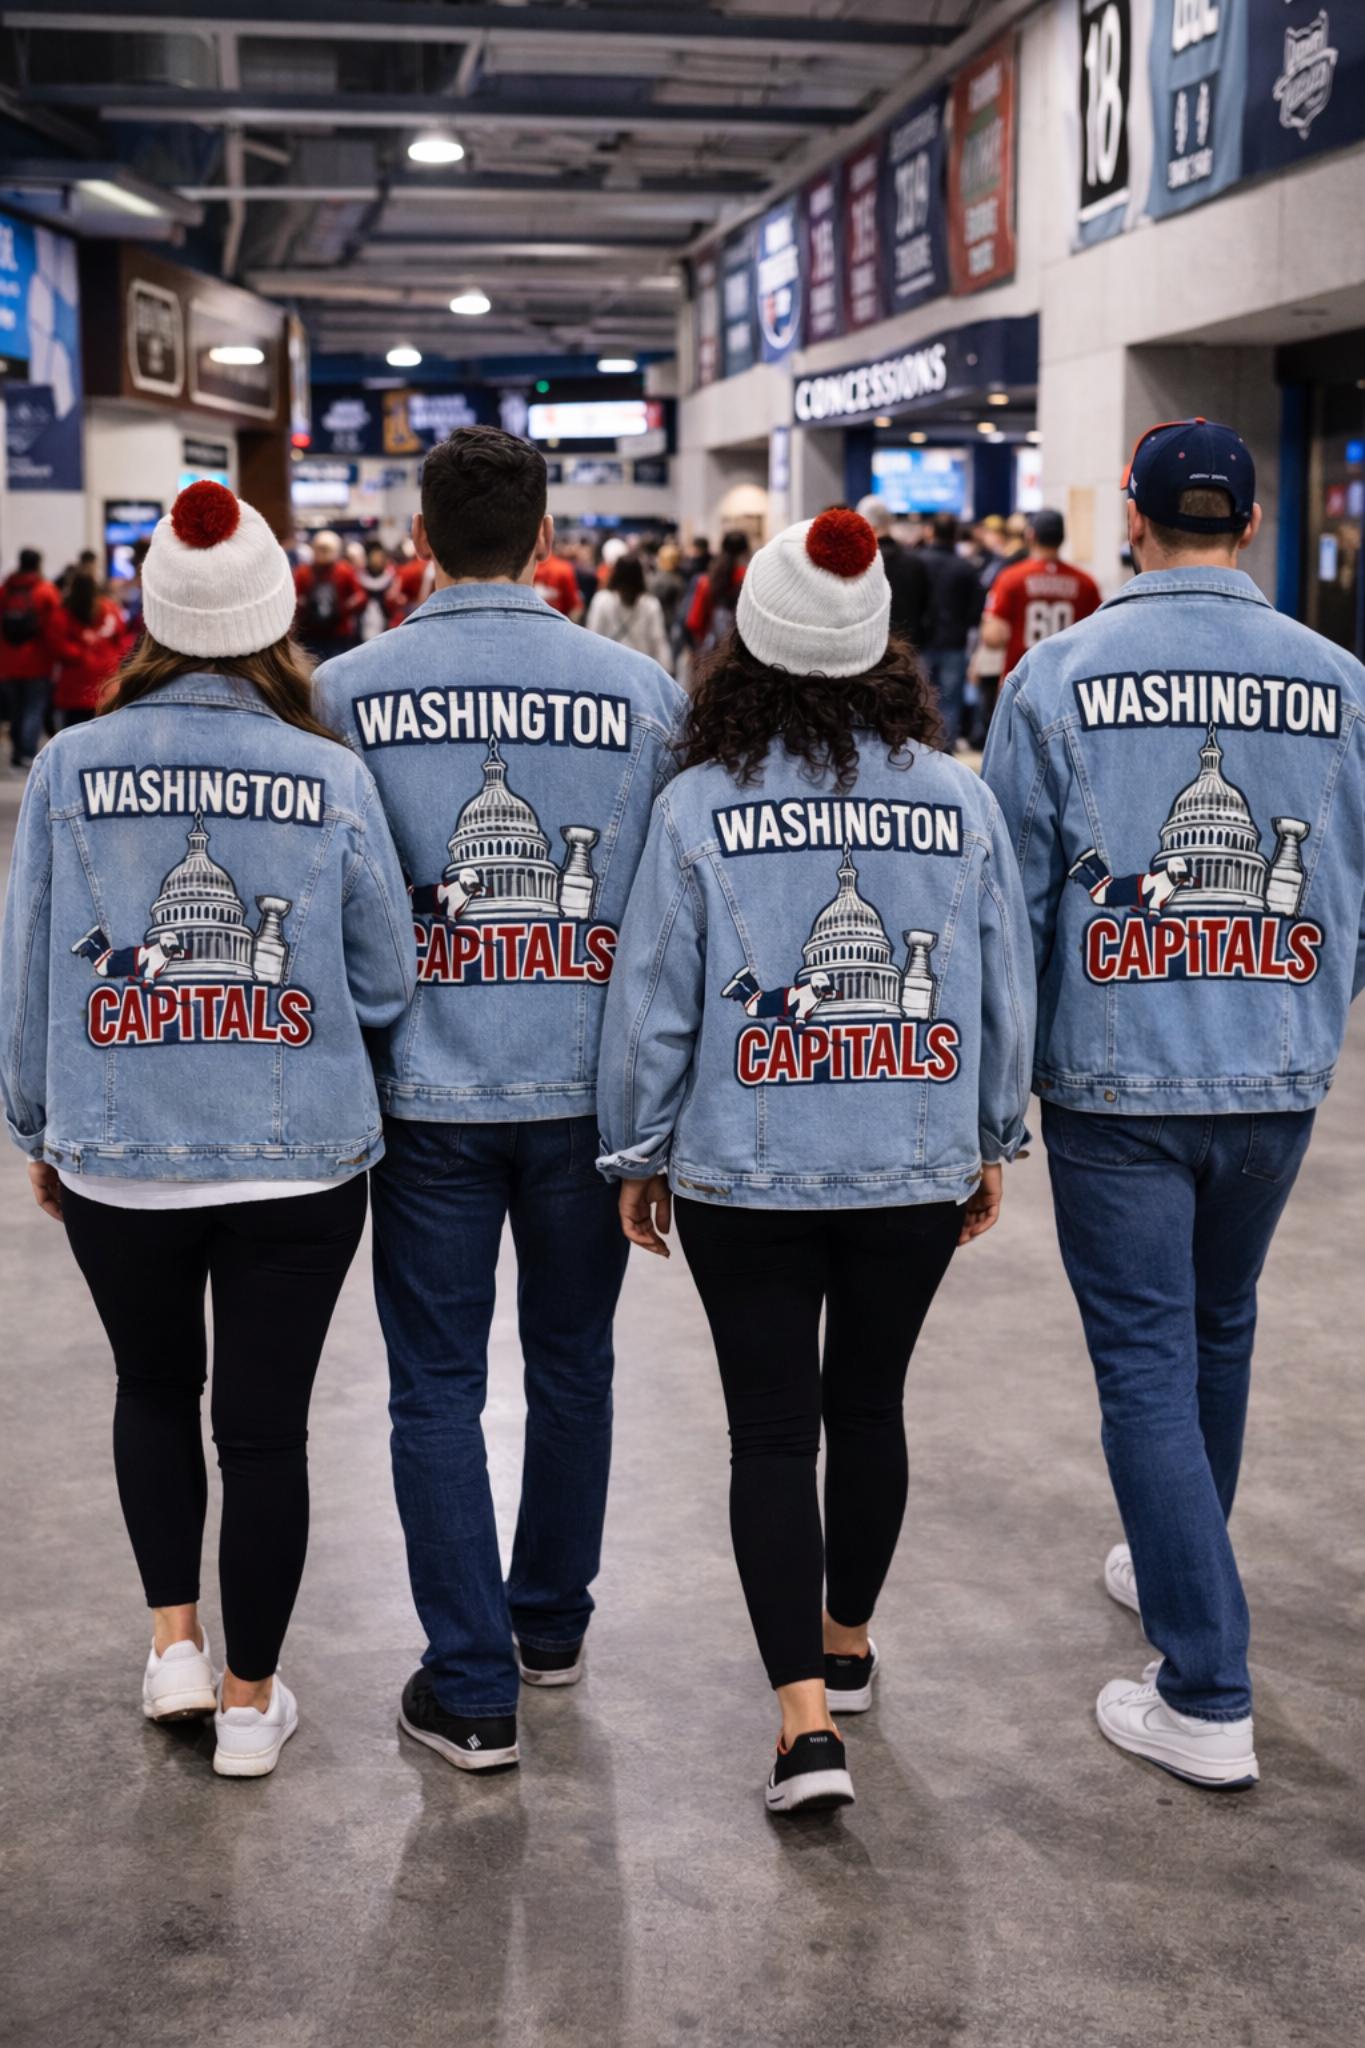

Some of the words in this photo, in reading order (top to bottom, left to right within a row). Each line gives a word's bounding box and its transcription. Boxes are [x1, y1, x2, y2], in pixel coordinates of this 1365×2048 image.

[1085, 4, 1122, 187] 18
[795, 343, 947, 421] CONCESSIONS
[356, 690, 627, 746] WASHINGTON
[1077, 674, 1336, 733] WASHINGTON
[83, 769, 322, 821] WASHINGTON
[717, 801, 958, 851] WASHINGTON
[1087, 917, 1321, 981] CAPITALS
[88, 985, 313, 1047] CAPITALS
[737, 1022, 960, 1085] CAPITALS
